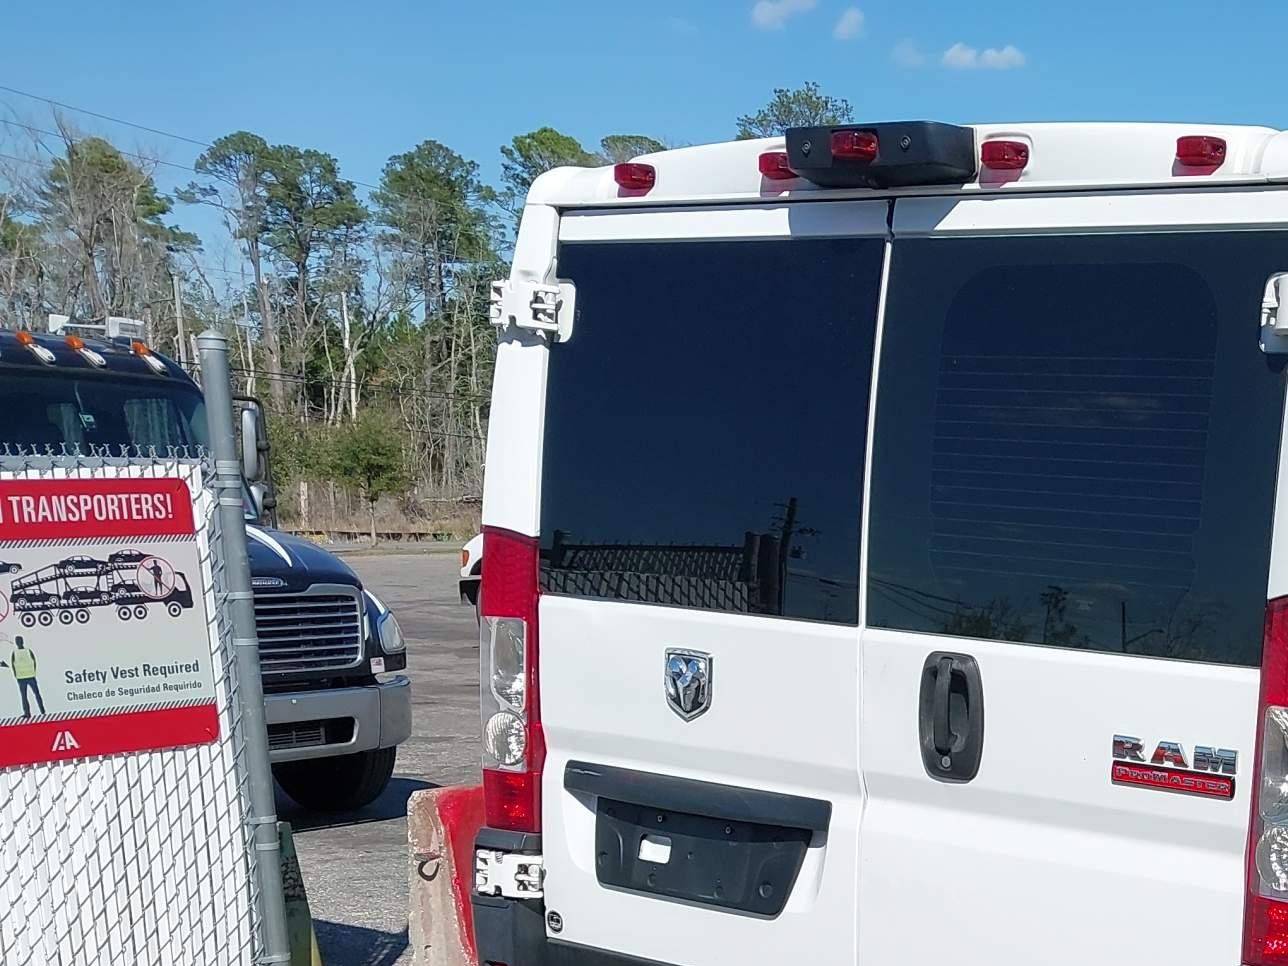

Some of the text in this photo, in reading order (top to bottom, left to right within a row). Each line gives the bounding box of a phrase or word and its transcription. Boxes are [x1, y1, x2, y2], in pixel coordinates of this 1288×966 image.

[8, 493, 173, 524] TRANSPORTERS!
[64, 659, 200, 684] Safety Vest Required
[66, 679, 203, 701] Chaleco de Seguridad Requirido
[1111, 734, 1239, 775] RAM
